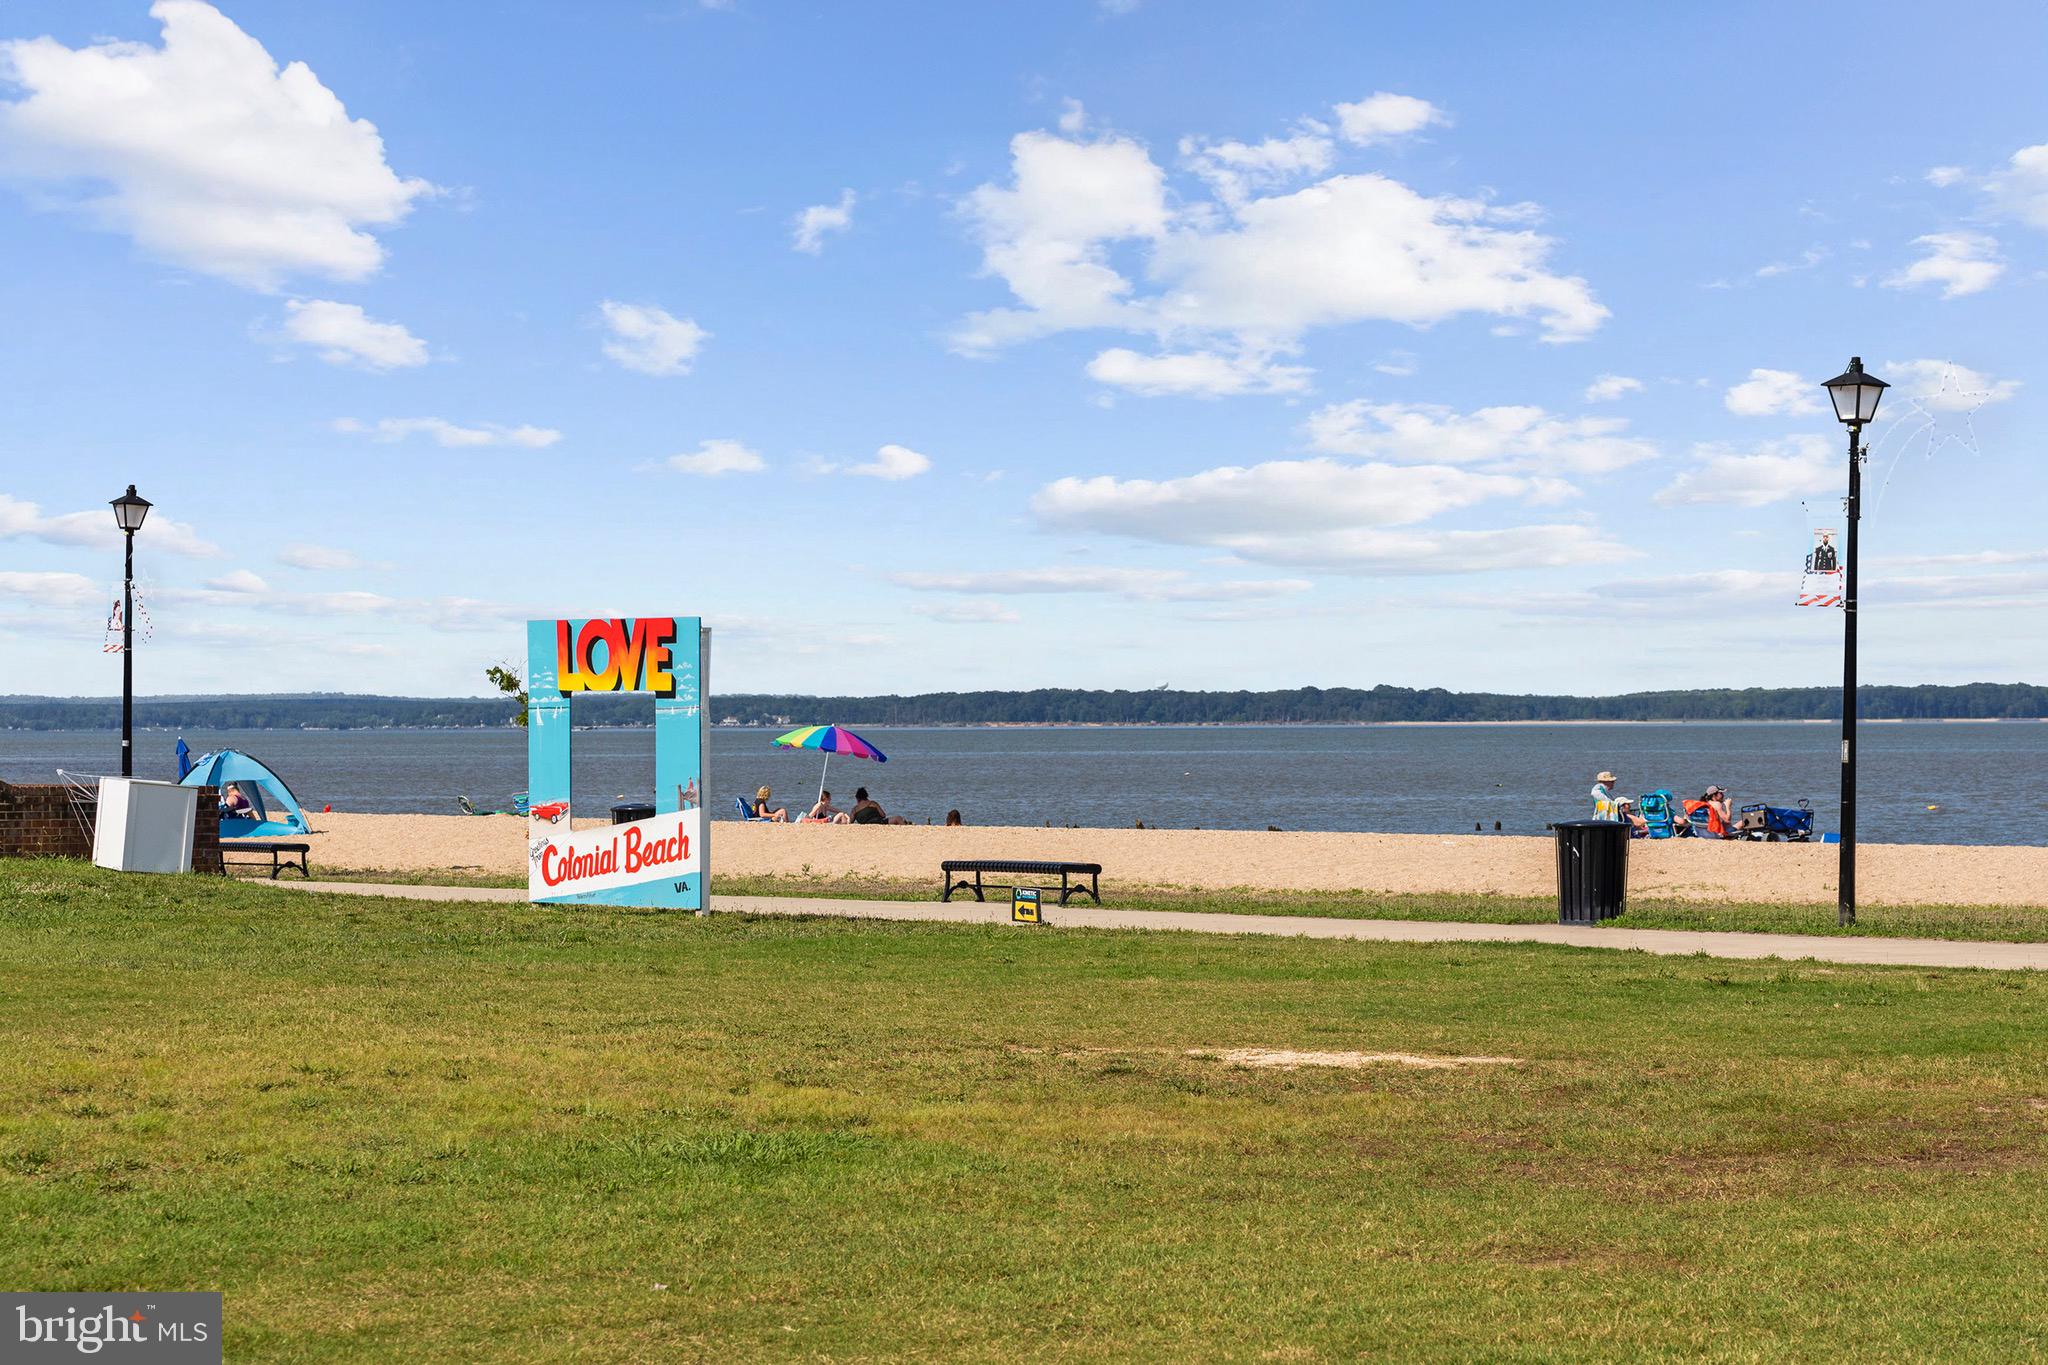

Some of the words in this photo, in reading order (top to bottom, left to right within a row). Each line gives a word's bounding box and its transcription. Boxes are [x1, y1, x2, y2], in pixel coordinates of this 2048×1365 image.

[557, 617, 676, 699] LOVE
[542, 836, 619, 887] Colonial
[623, 821, 691, 873] Beach
[674, 881, 691, 893] VA.
